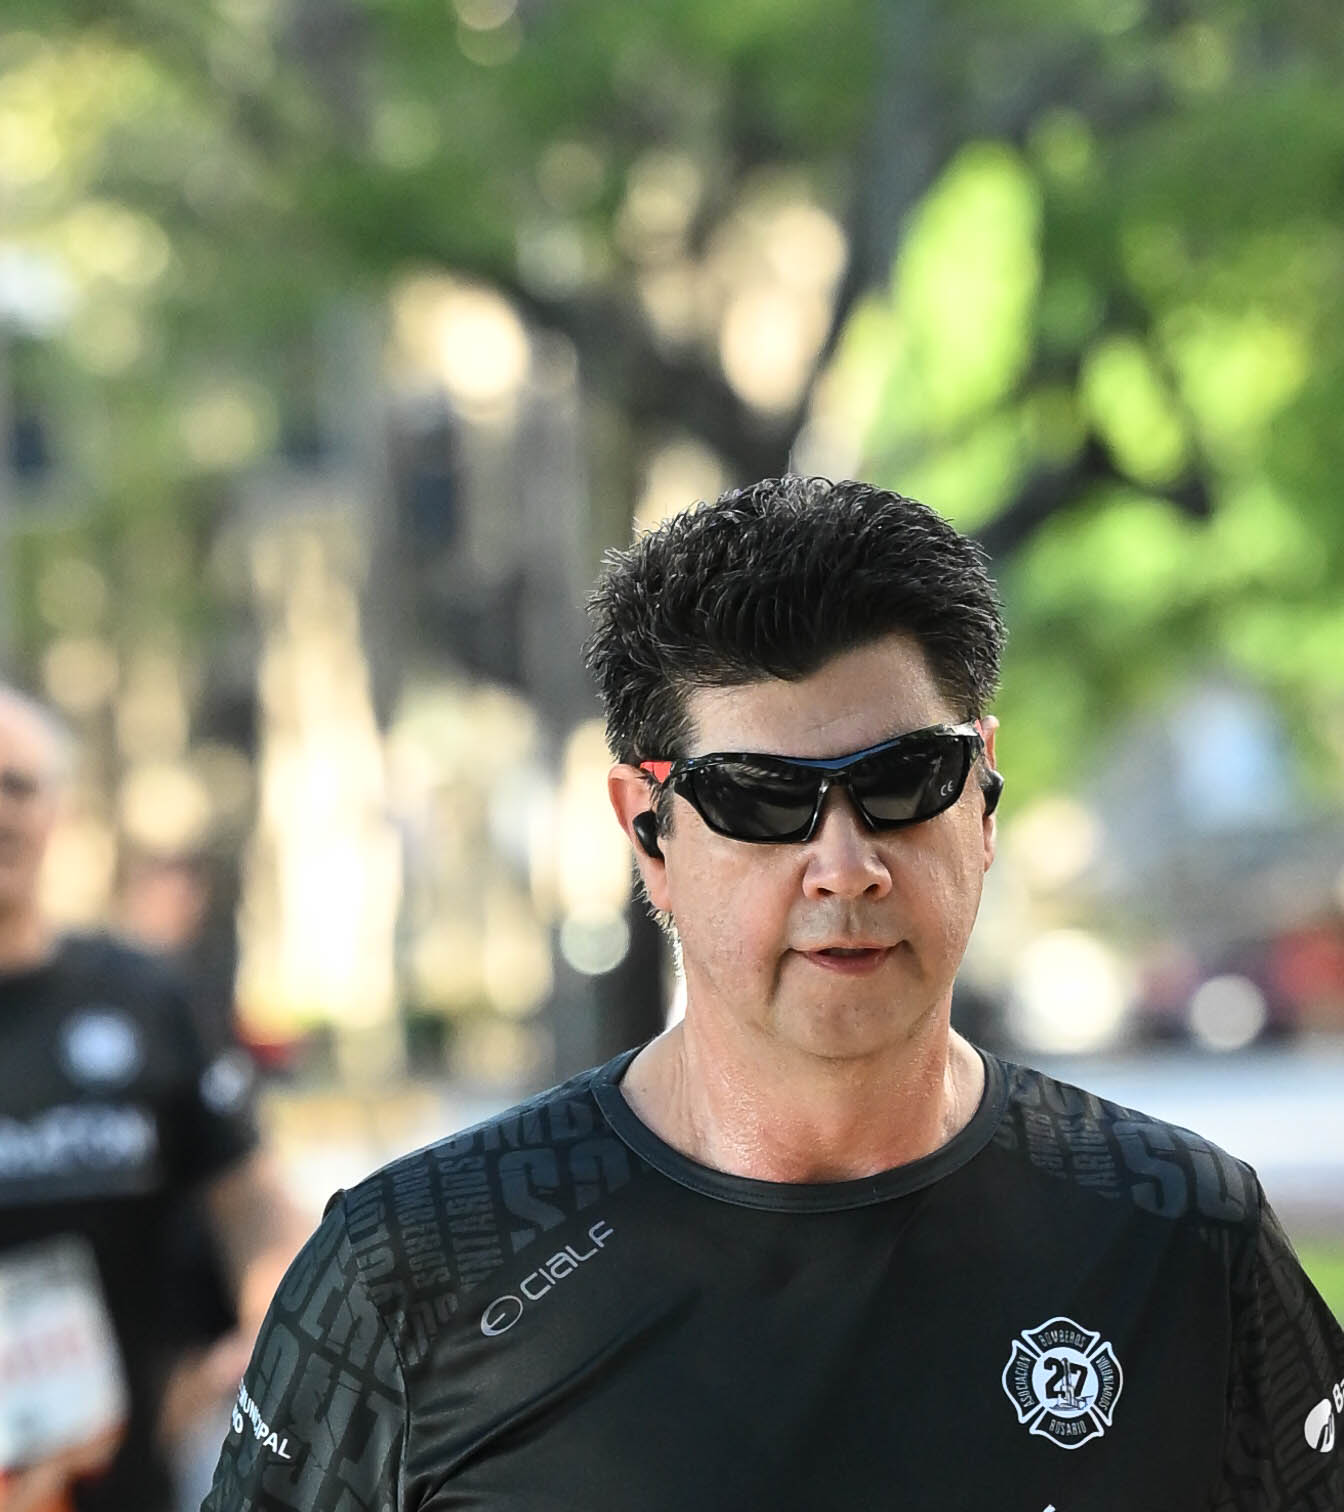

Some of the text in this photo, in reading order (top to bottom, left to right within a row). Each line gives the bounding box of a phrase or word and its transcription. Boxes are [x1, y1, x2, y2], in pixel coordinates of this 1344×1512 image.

[1038, 1329, 1086, 1348] BOMBEROS
[1043, 1356, 1088, 1400] 27
[1049, 1419, 1087, 1436] ROSARIO
